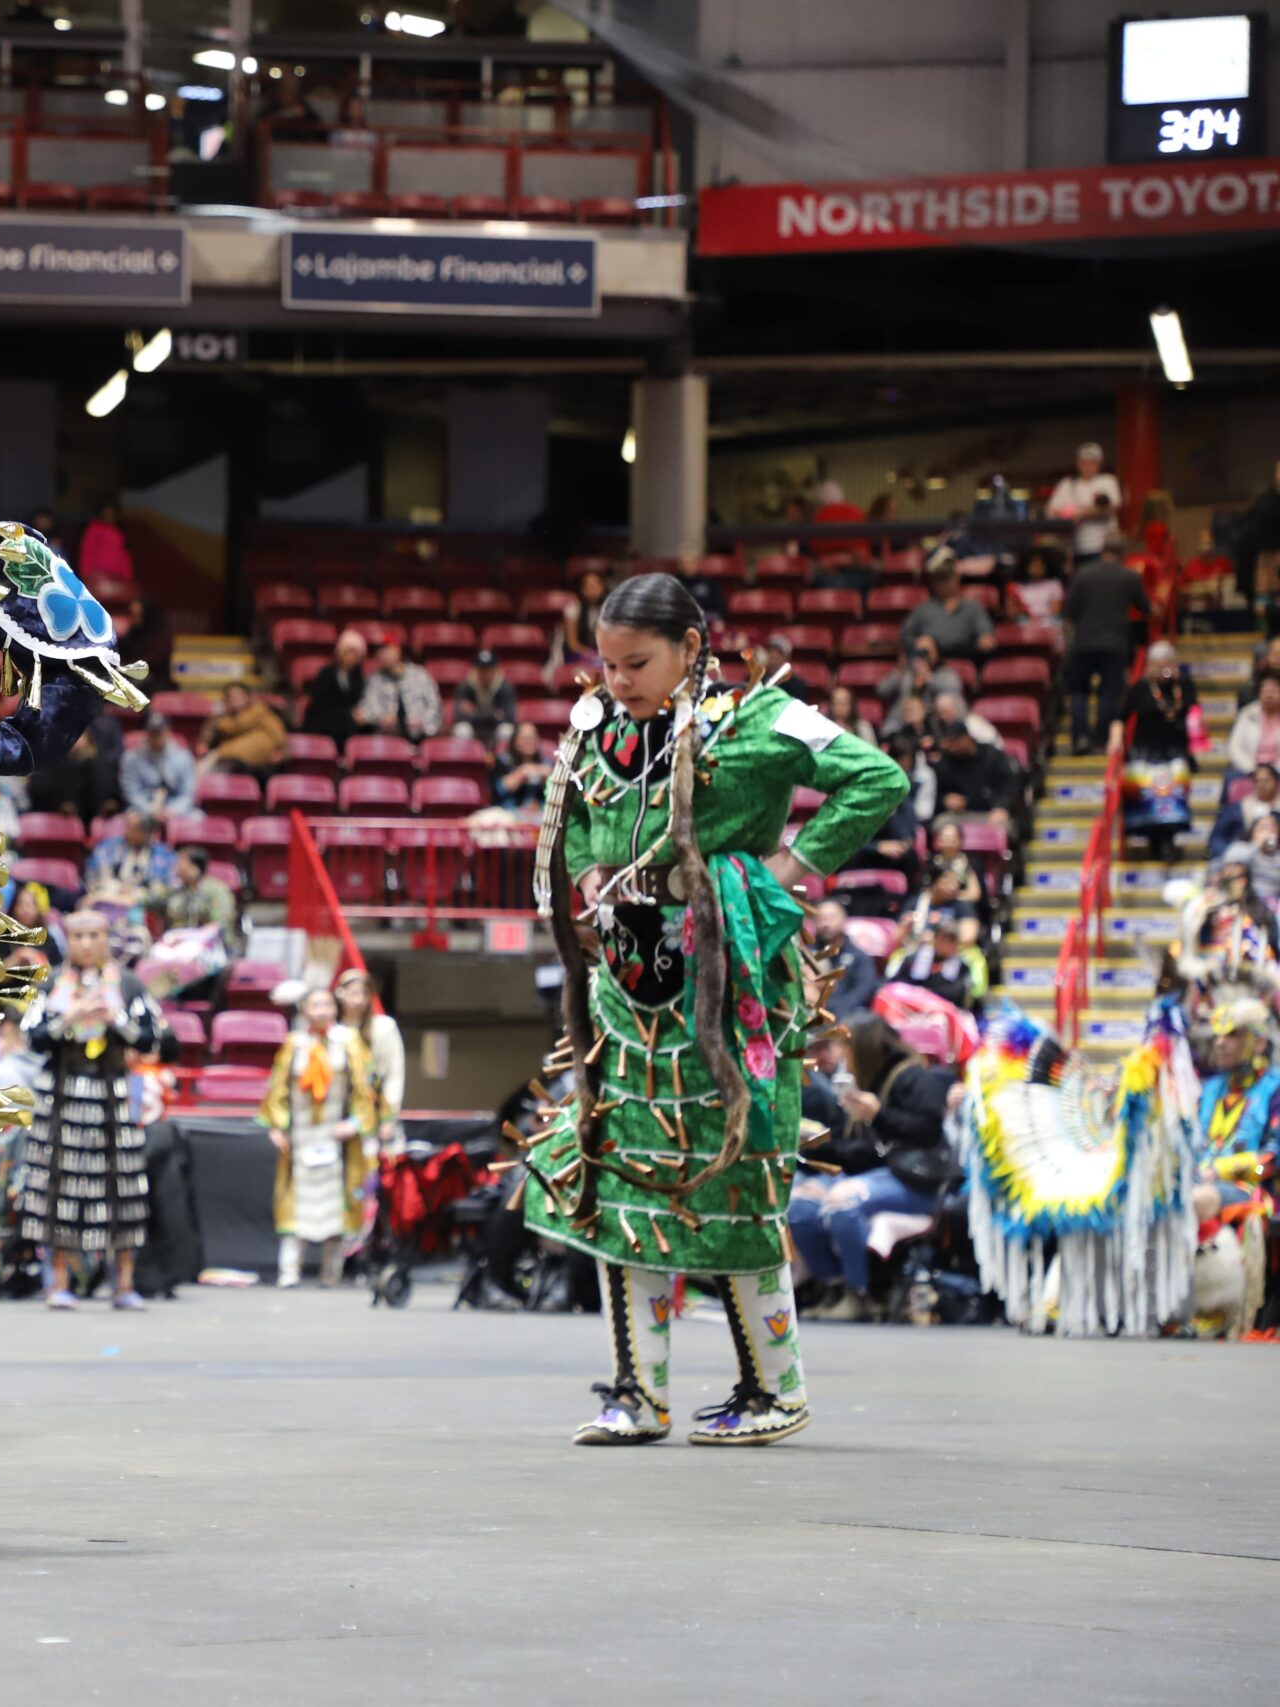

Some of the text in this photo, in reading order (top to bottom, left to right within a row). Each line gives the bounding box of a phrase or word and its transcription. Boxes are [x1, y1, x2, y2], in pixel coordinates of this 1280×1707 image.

[1158, 108, 1240, 153] 3:04
[777, 170, 1280, 238] NORTHSIDE TOYOT
[176, 333, 238, 361] 101
